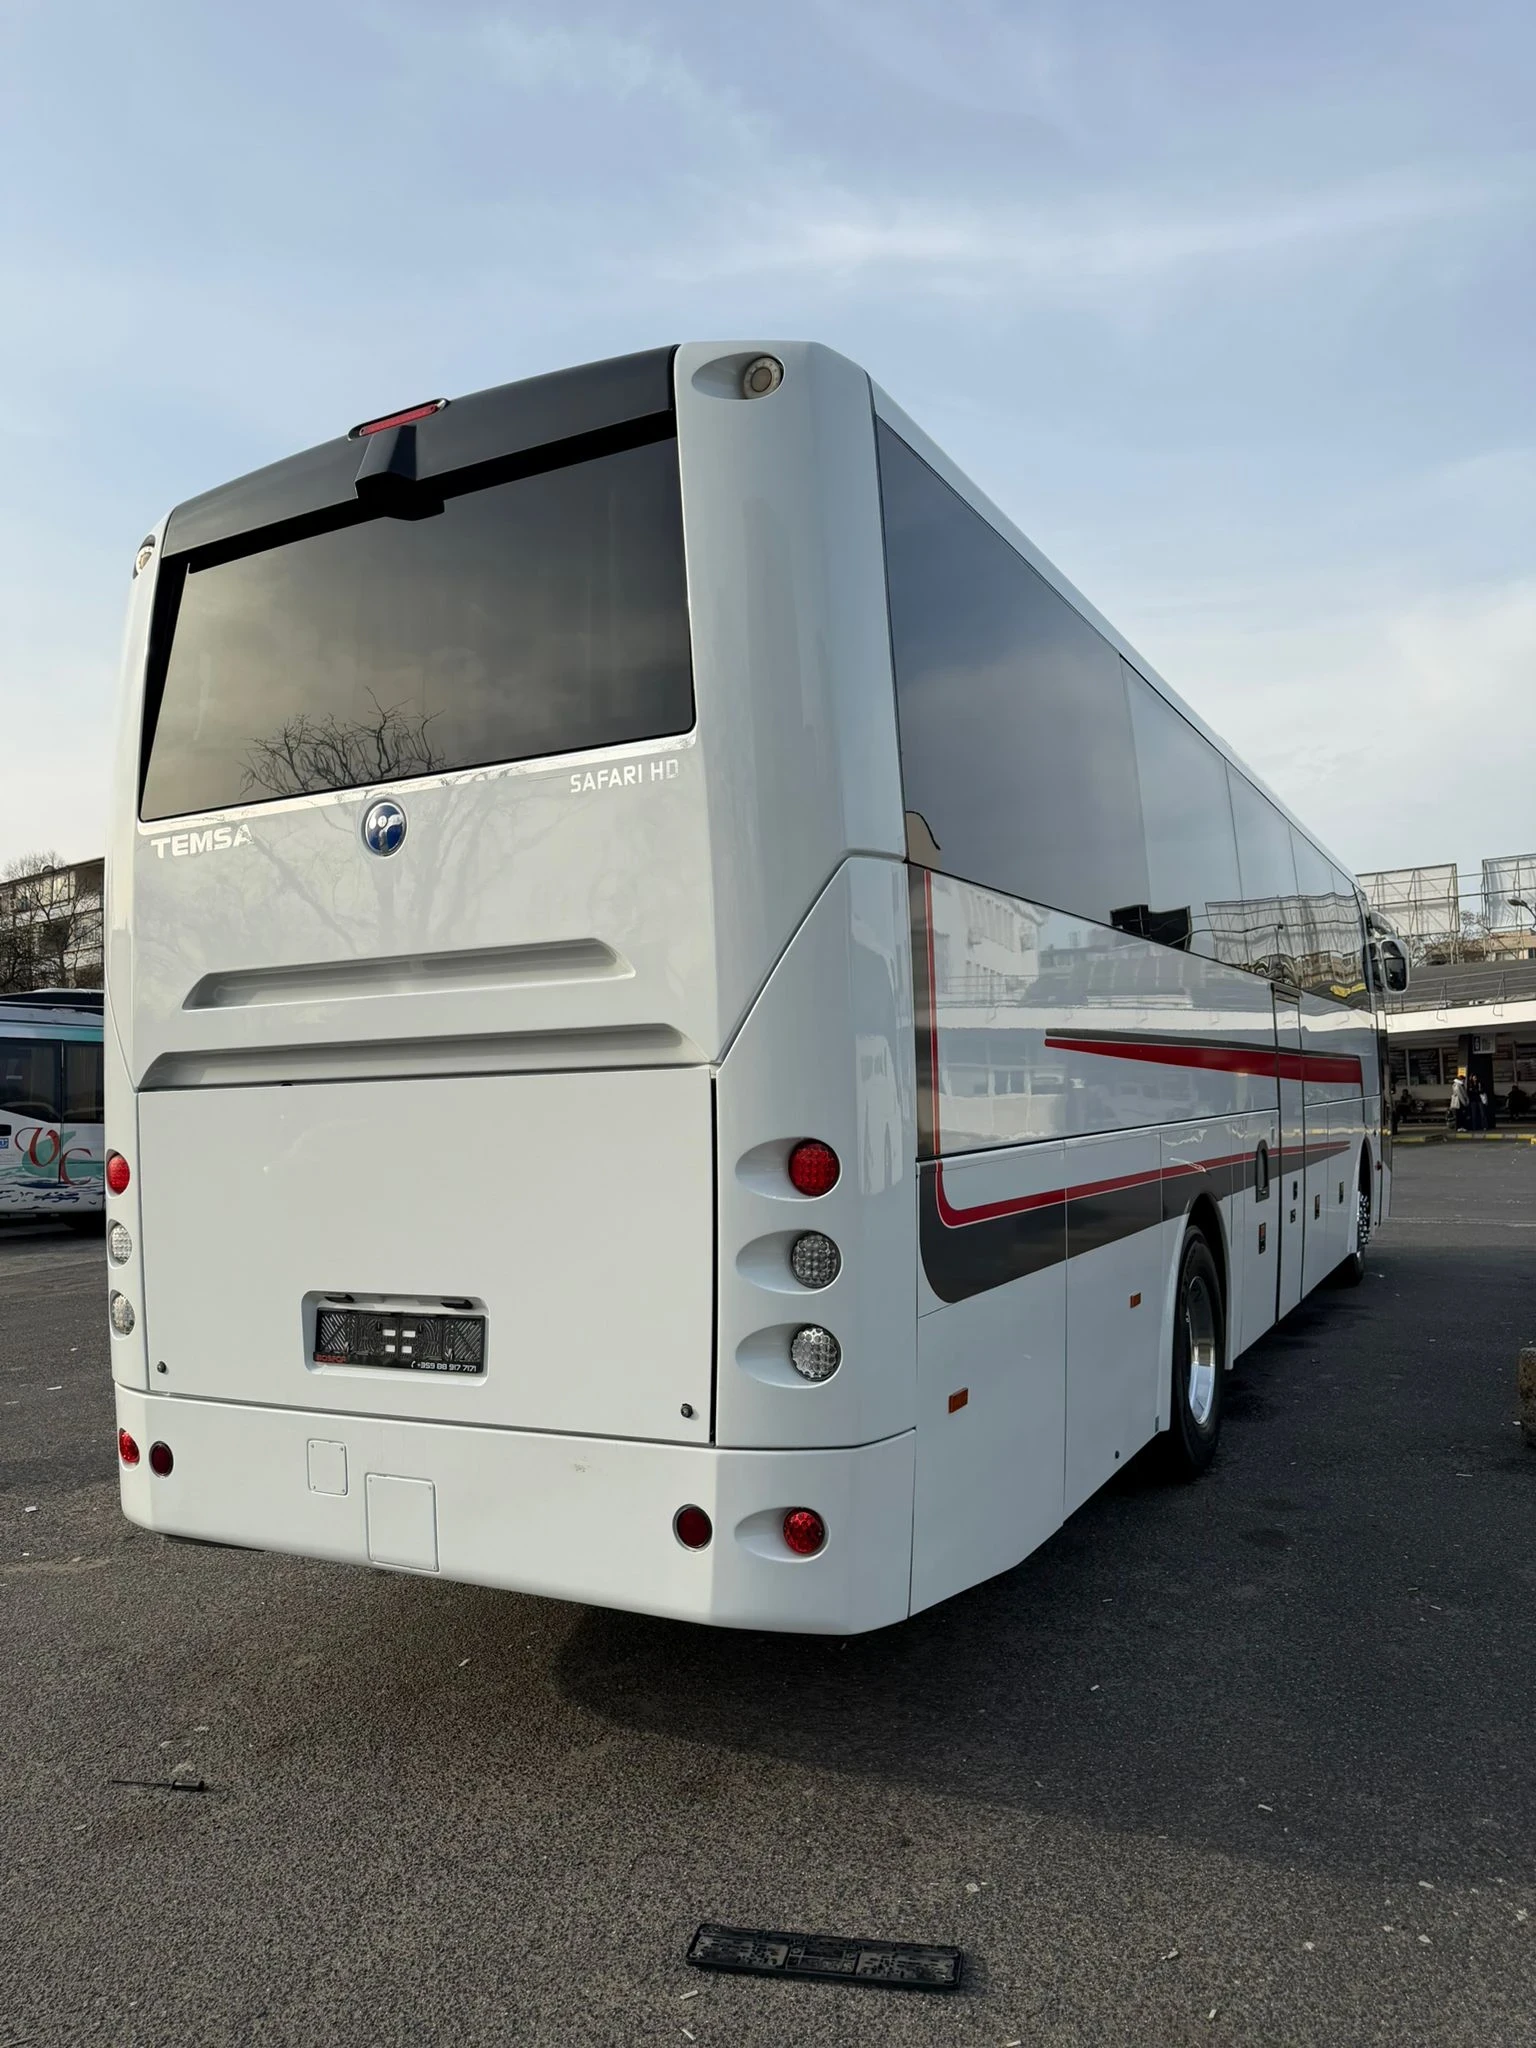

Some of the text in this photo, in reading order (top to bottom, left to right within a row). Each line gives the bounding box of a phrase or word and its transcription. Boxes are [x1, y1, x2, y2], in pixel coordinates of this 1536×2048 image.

[570, 759, 679, 793] SAFARI HD
[150, 824, 254, 859] TEMSA
